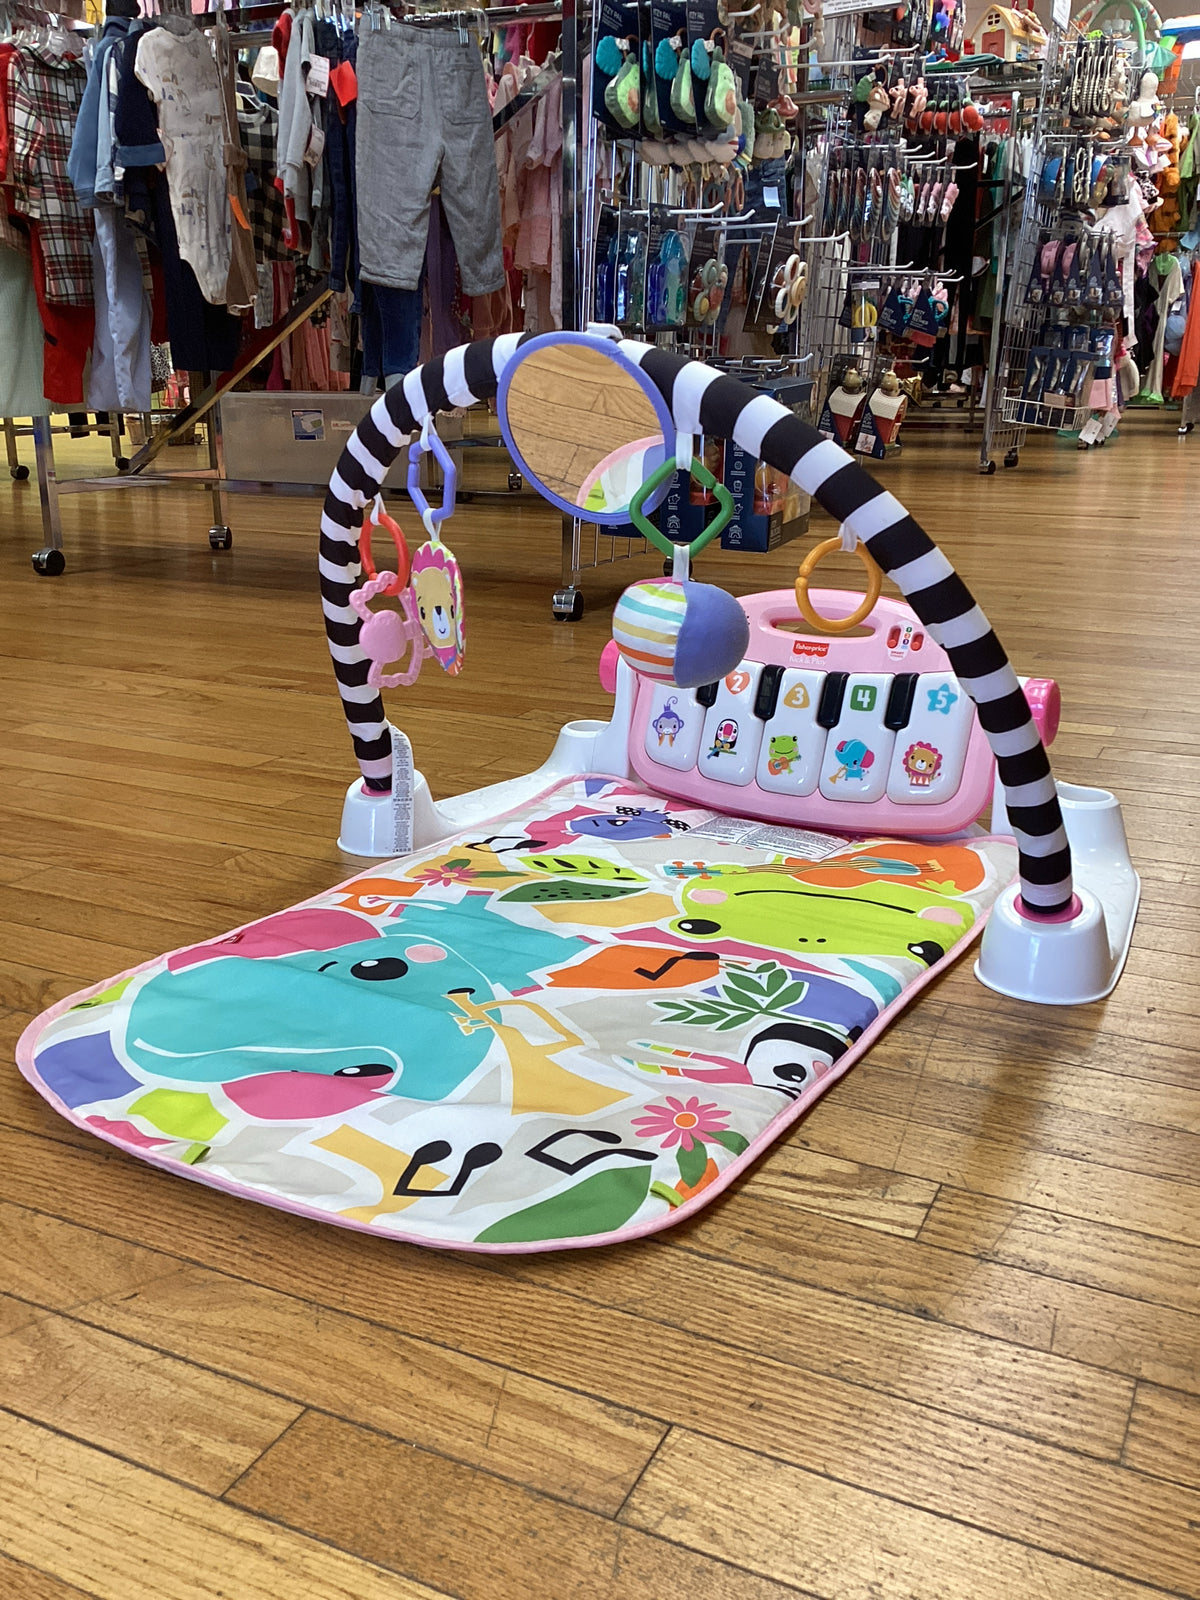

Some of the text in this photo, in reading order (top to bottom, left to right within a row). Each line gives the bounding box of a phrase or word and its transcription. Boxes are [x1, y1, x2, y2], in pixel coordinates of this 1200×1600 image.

[731, 674, 744, 692] 2
[791, 683, 804, 705] 3
[856, 689, 871, 708] 4
[935, 691, 947, 708] 5
